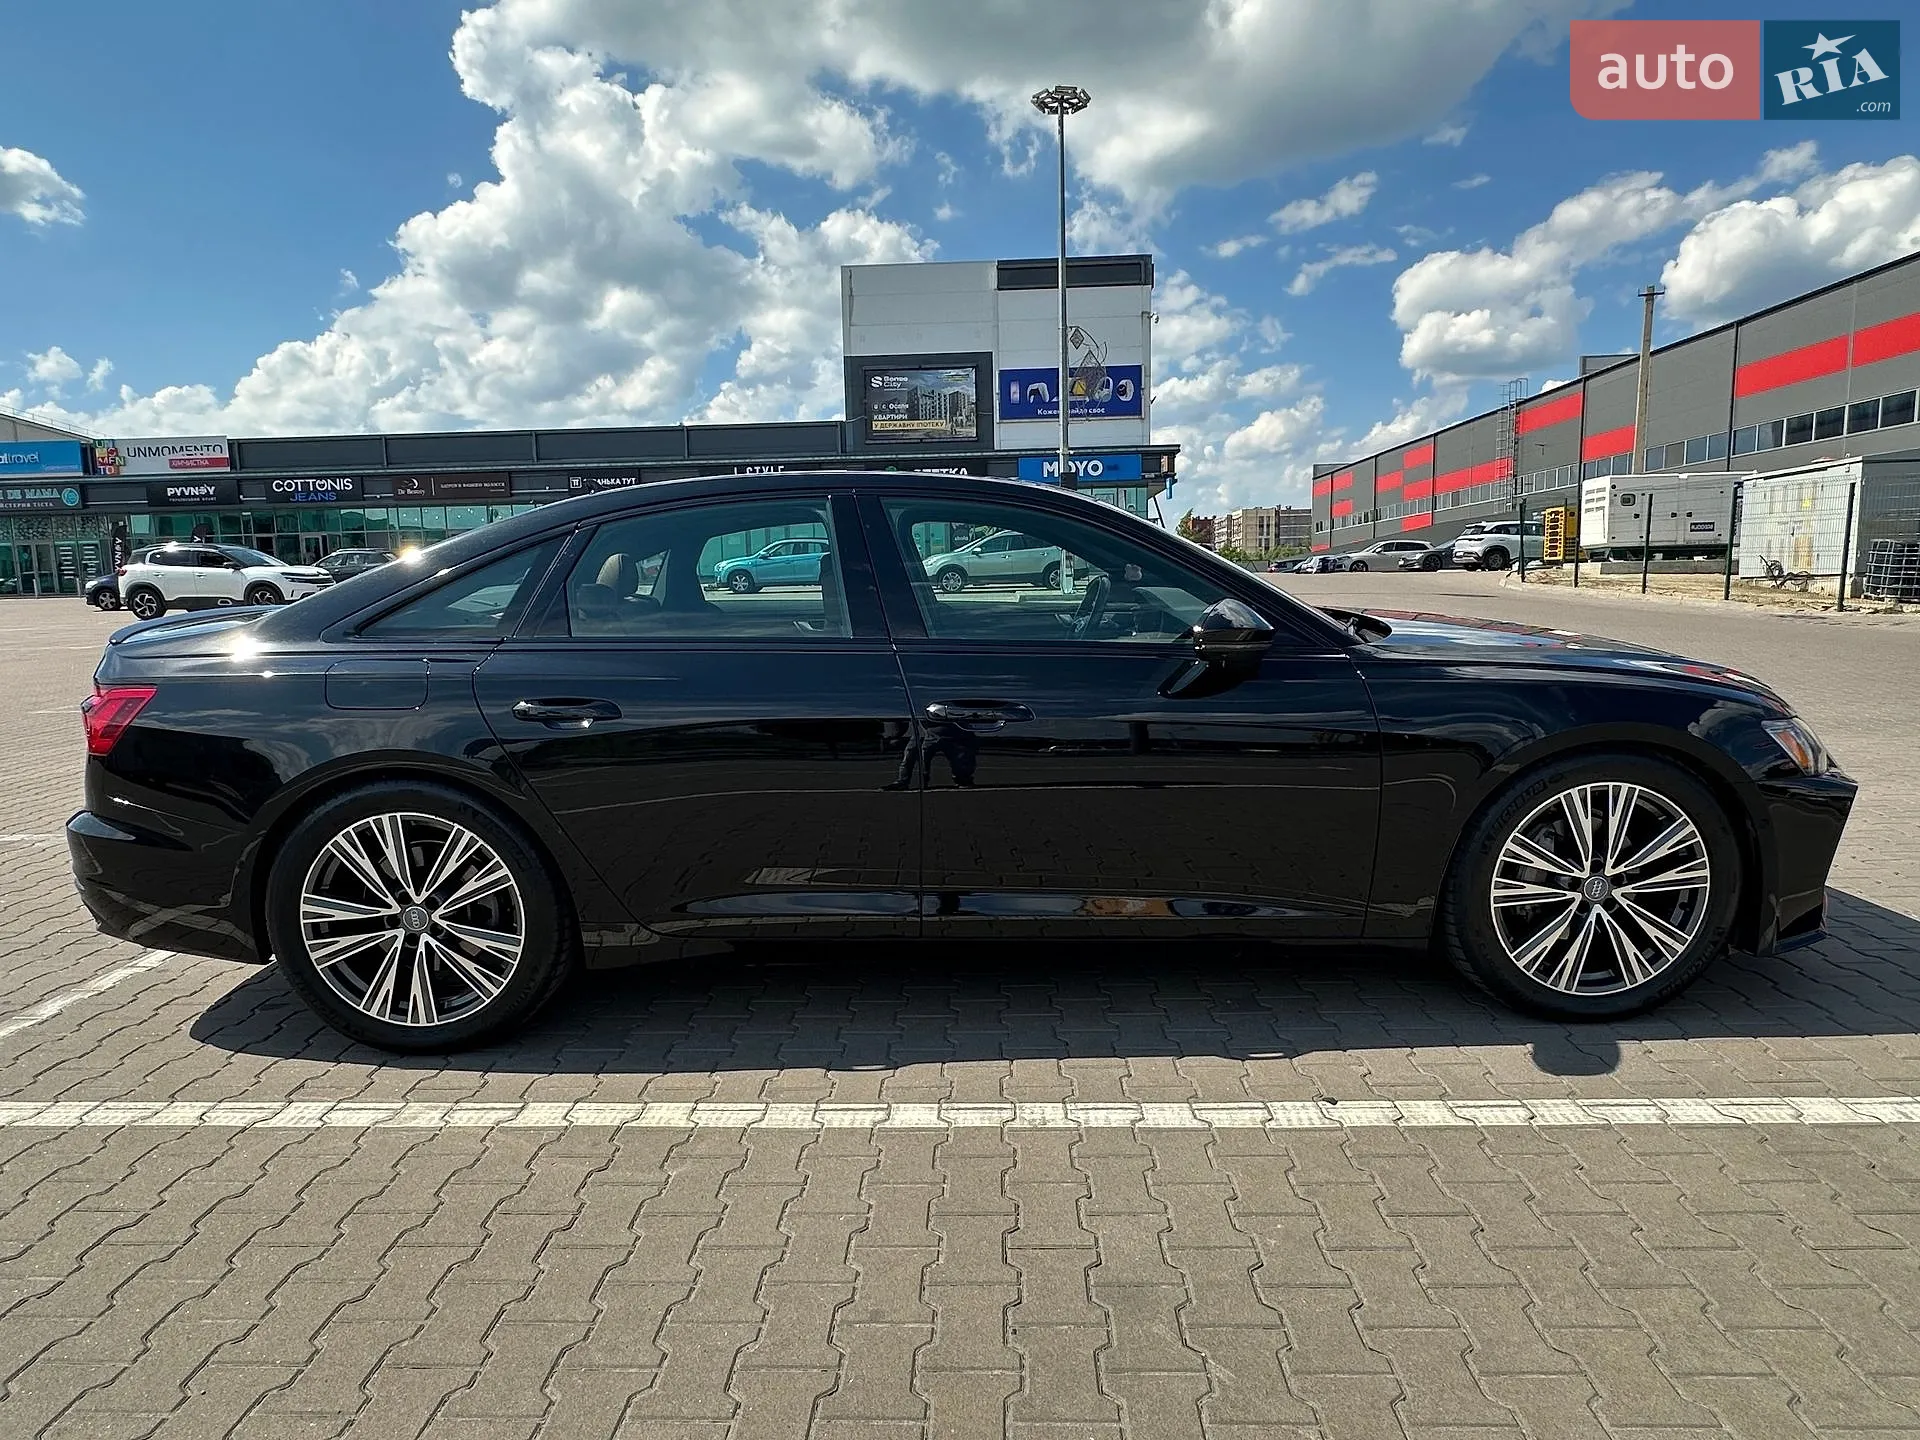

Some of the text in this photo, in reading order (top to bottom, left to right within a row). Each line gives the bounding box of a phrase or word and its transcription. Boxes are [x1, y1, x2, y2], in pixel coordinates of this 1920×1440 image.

[127, 444, 223, 458] UNMOMENTO
[272, 478, 353, 492] COTTONIS
[621, 477, 637, 485] ТУТ
[25, 488, 60, 499] MAMA
[290, 492, 337, 502] JEANS
